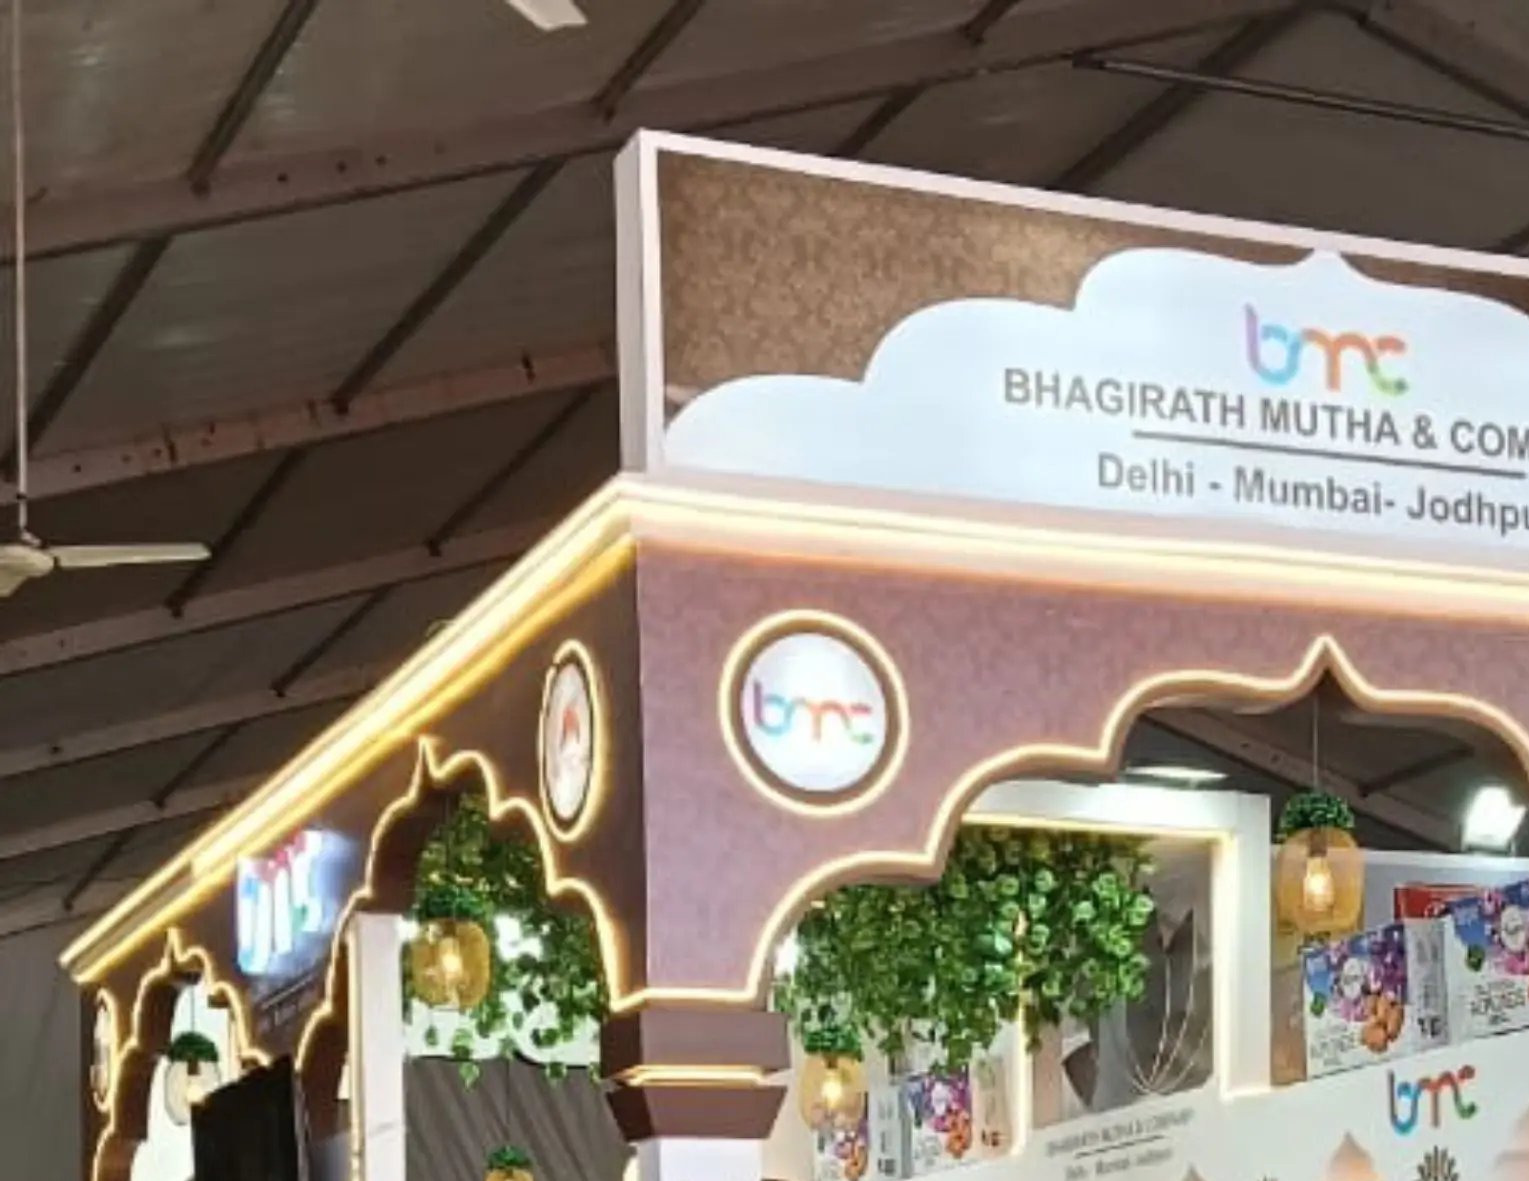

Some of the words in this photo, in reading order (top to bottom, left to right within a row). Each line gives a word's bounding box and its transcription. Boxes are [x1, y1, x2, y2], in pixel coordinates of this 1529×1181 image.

[1244, 301, 1408, 396] bmc
[1004, 367, 1246, 430] BHAGIRATH
[1260, 398, 1400, 446] MUTHA
[1412, 416, 1438, 452] &
[1097, 452, 1196, 498] Delhi
[753, 677, 874, 744] bmc
